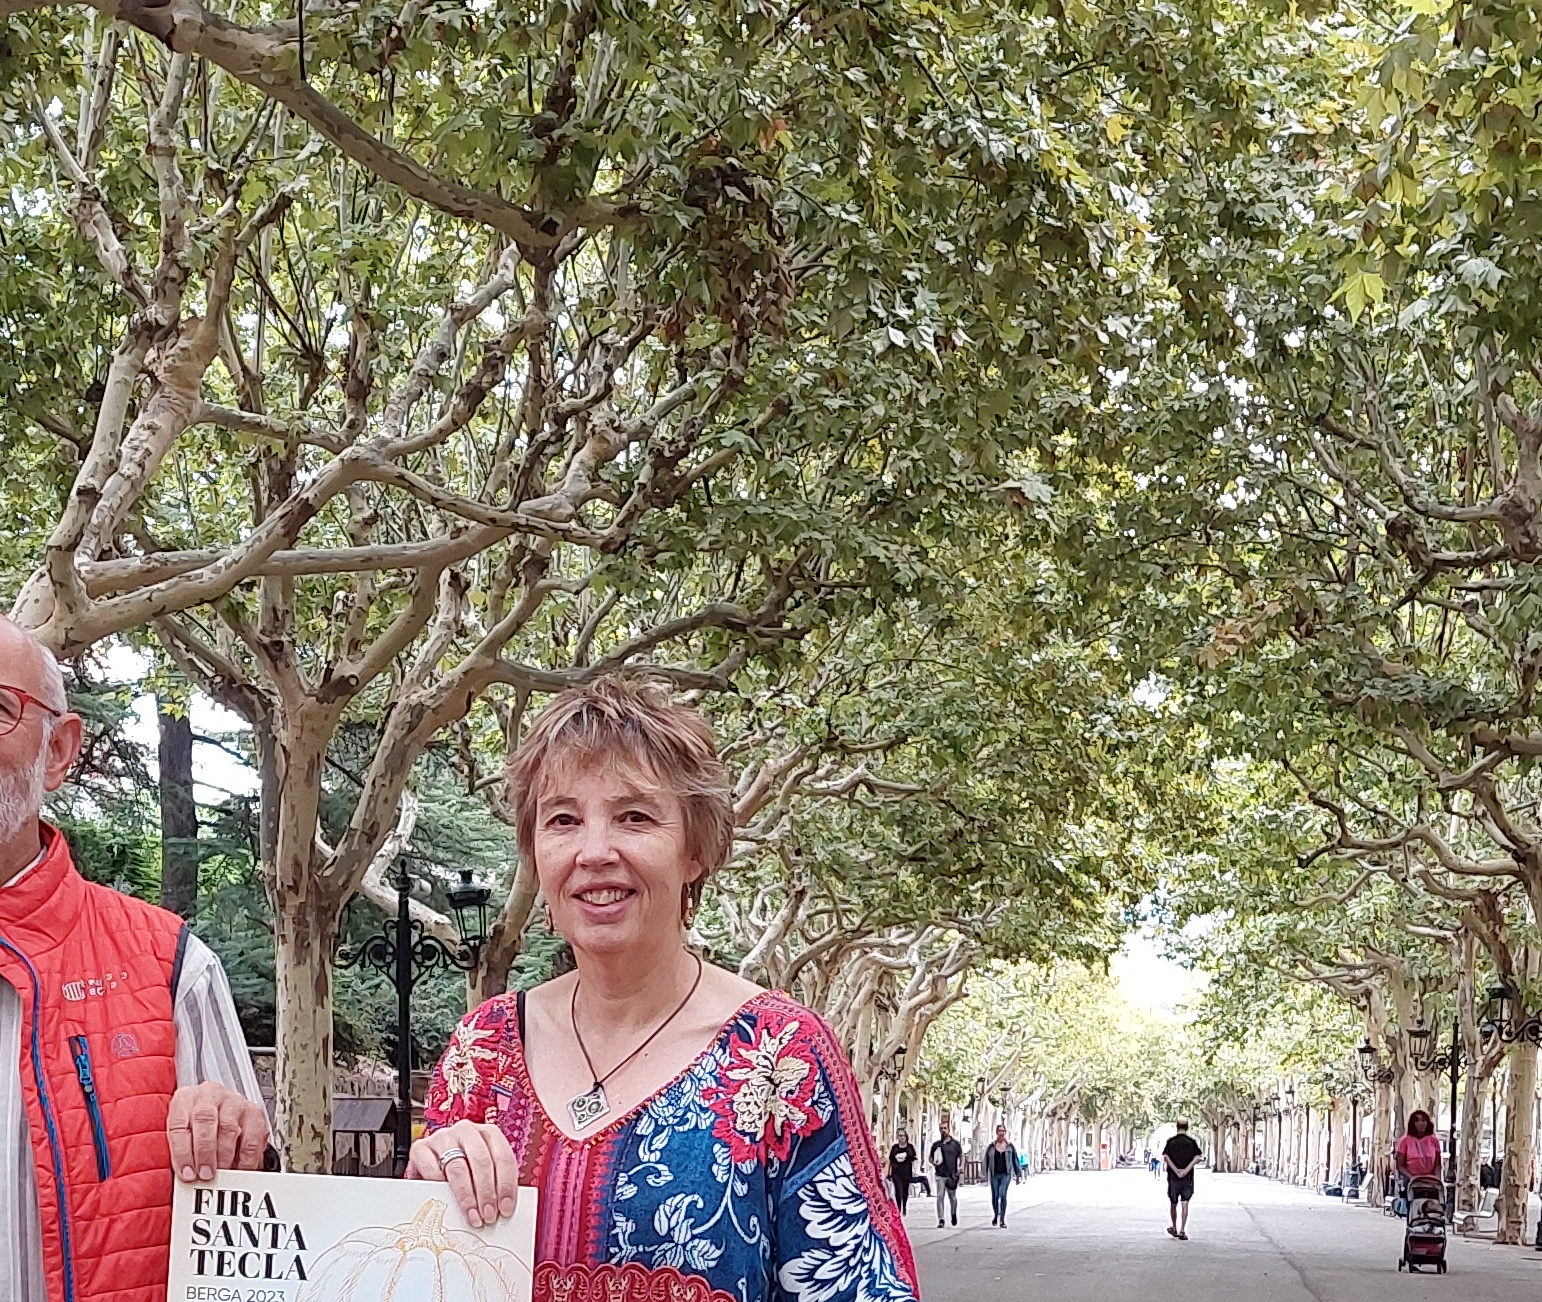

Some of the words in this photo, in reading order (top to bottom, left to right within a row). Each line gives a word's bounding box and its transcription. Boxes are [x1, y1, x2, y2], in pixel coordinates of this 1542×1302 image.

[192, 1188, 280, 1219] FIRA
[191, 1218, 309, 1251] SANTA
[189, 1249, 310, 1281] TECLA
[186, 1286, 242, 1302] BERGA
